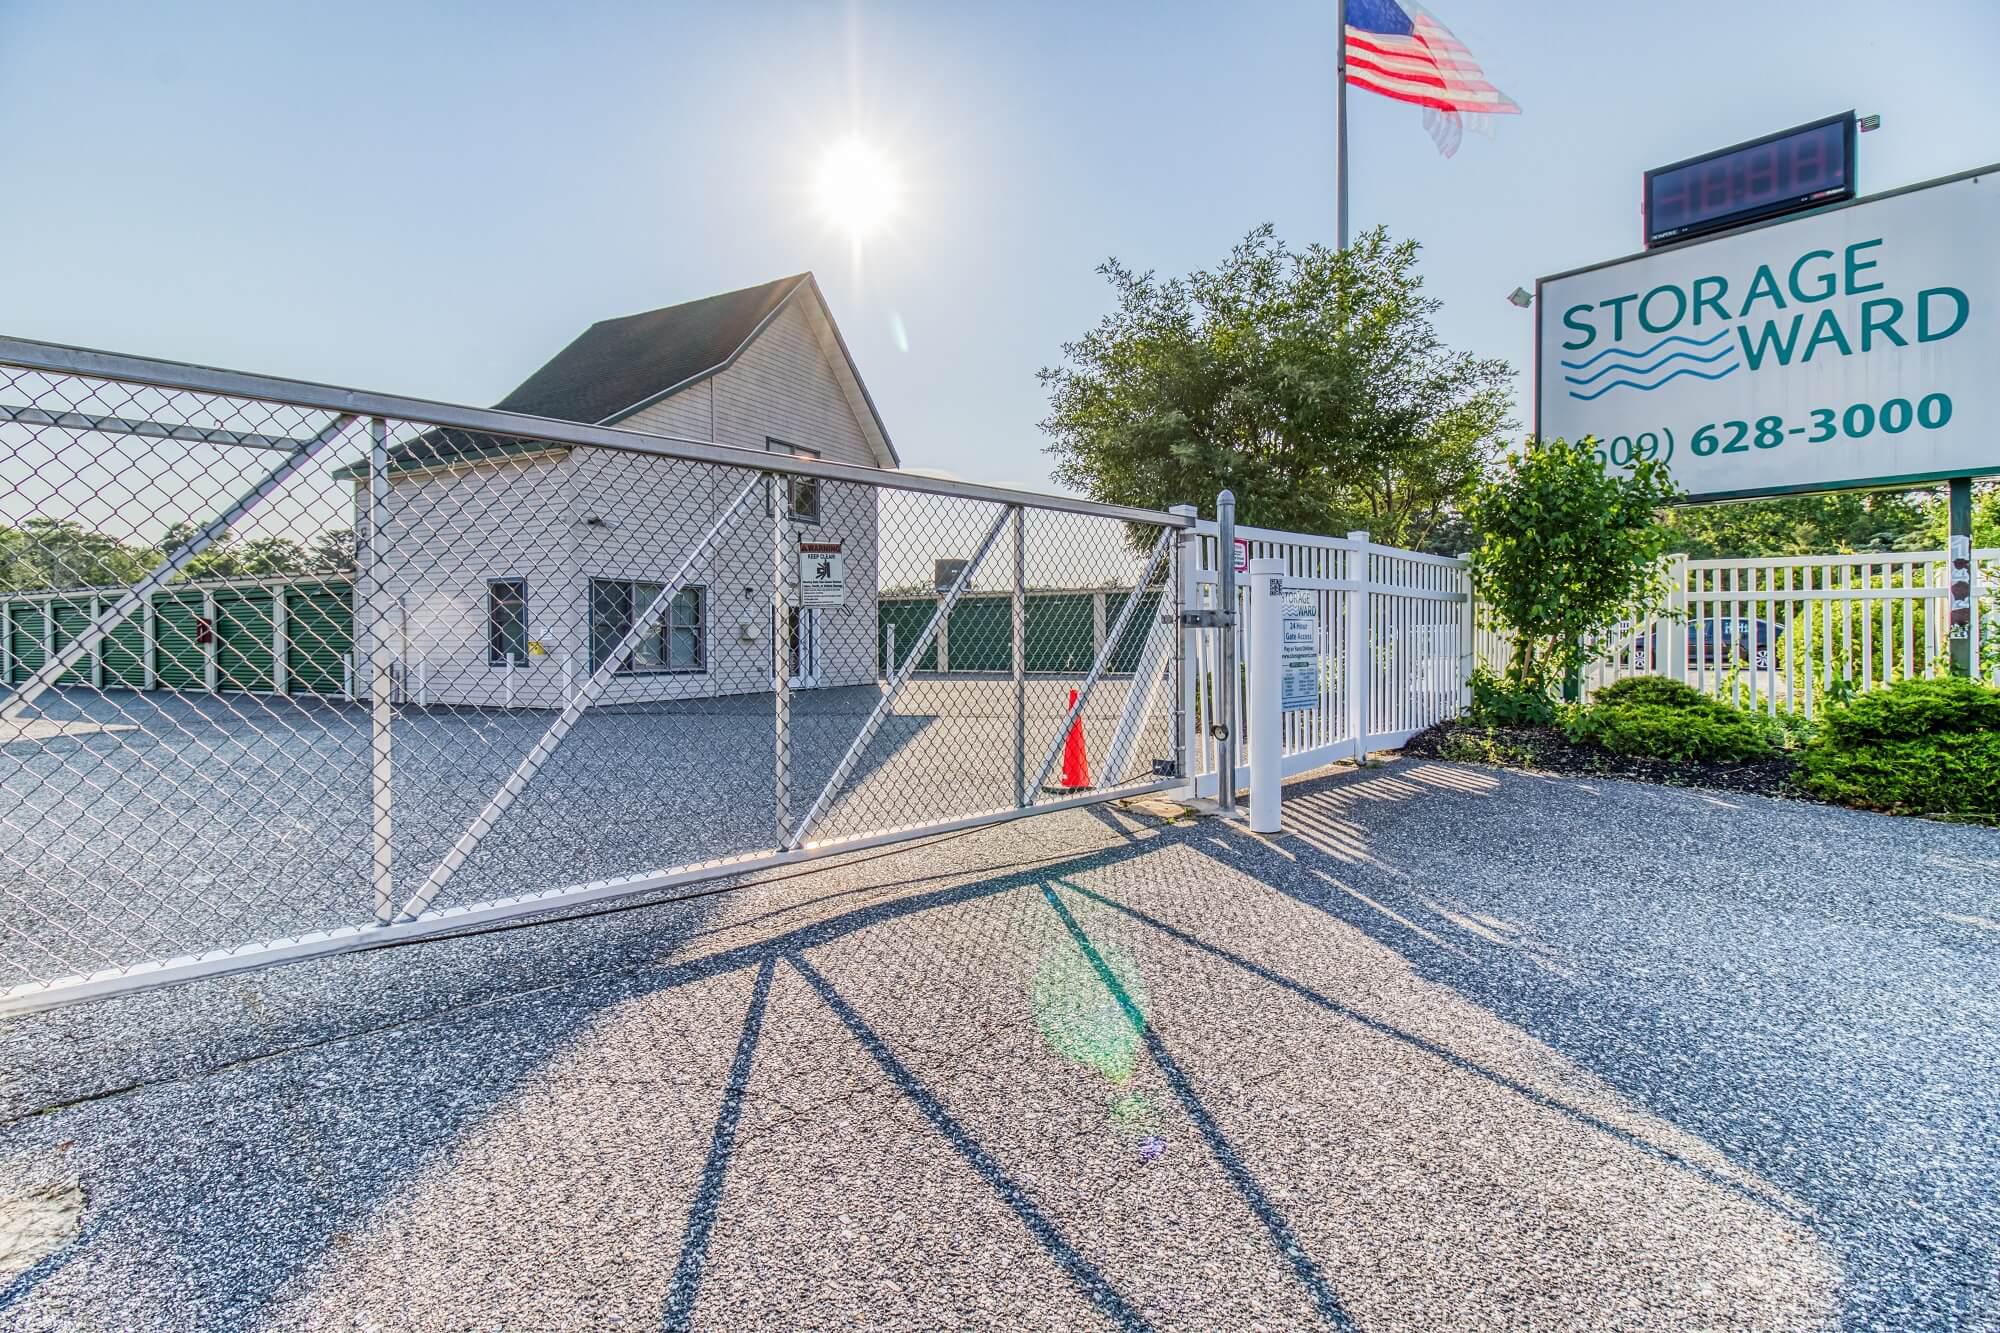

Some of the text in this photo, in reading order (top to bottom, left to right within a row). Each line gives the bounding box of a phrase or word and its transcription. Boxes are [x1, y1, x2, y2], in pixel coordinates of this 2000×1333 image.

[1562, 238, 1884, 351] STORAGE
[1737, 286, 1970, 371] WARD
[1573, 392, 1953, 473] 09) 628-3000
[1281, 592, 1310, 604] STORAGE
[1297, 605, 1316, 616] WARD
[1286, 632, 1296, 640] Gate
